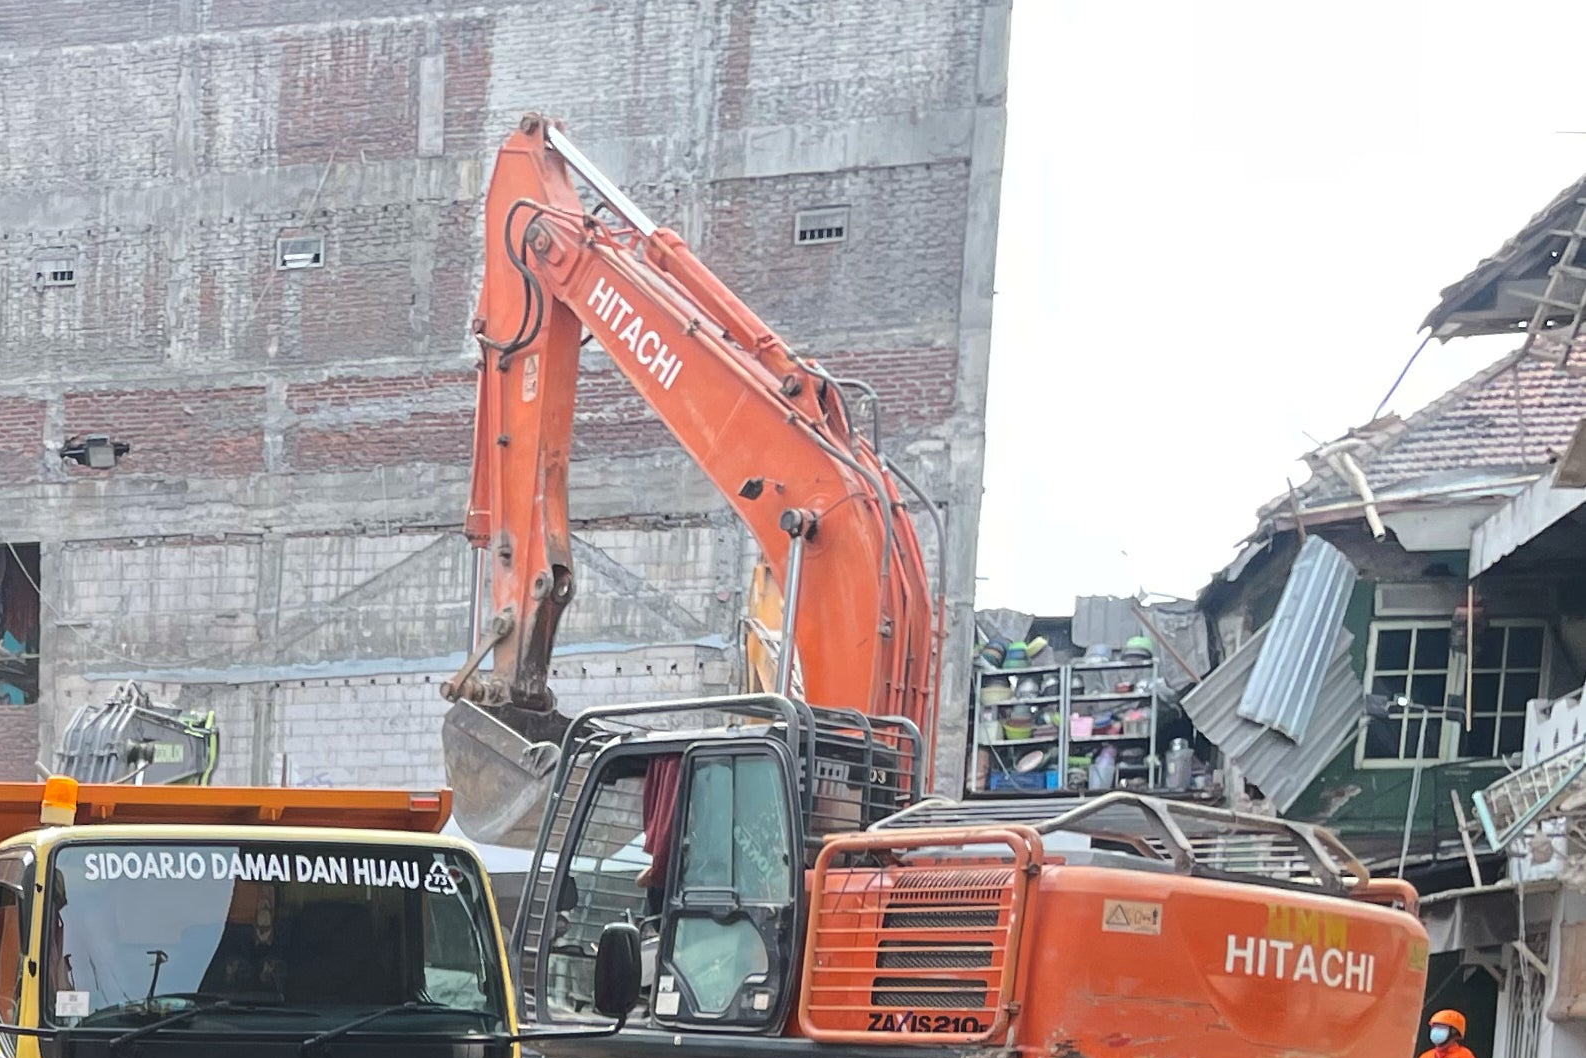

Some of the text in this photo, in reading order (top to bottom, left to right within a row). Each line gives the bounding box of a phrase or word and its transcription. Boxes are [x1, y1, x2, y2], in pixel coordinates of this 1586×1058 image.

[587, 277, 684, 390] HITACHI
[84, 851, 420, 890] SIDOARJO DAMAI DAN HIJAU
[1225, 934, 1374, 993] HITACHI
